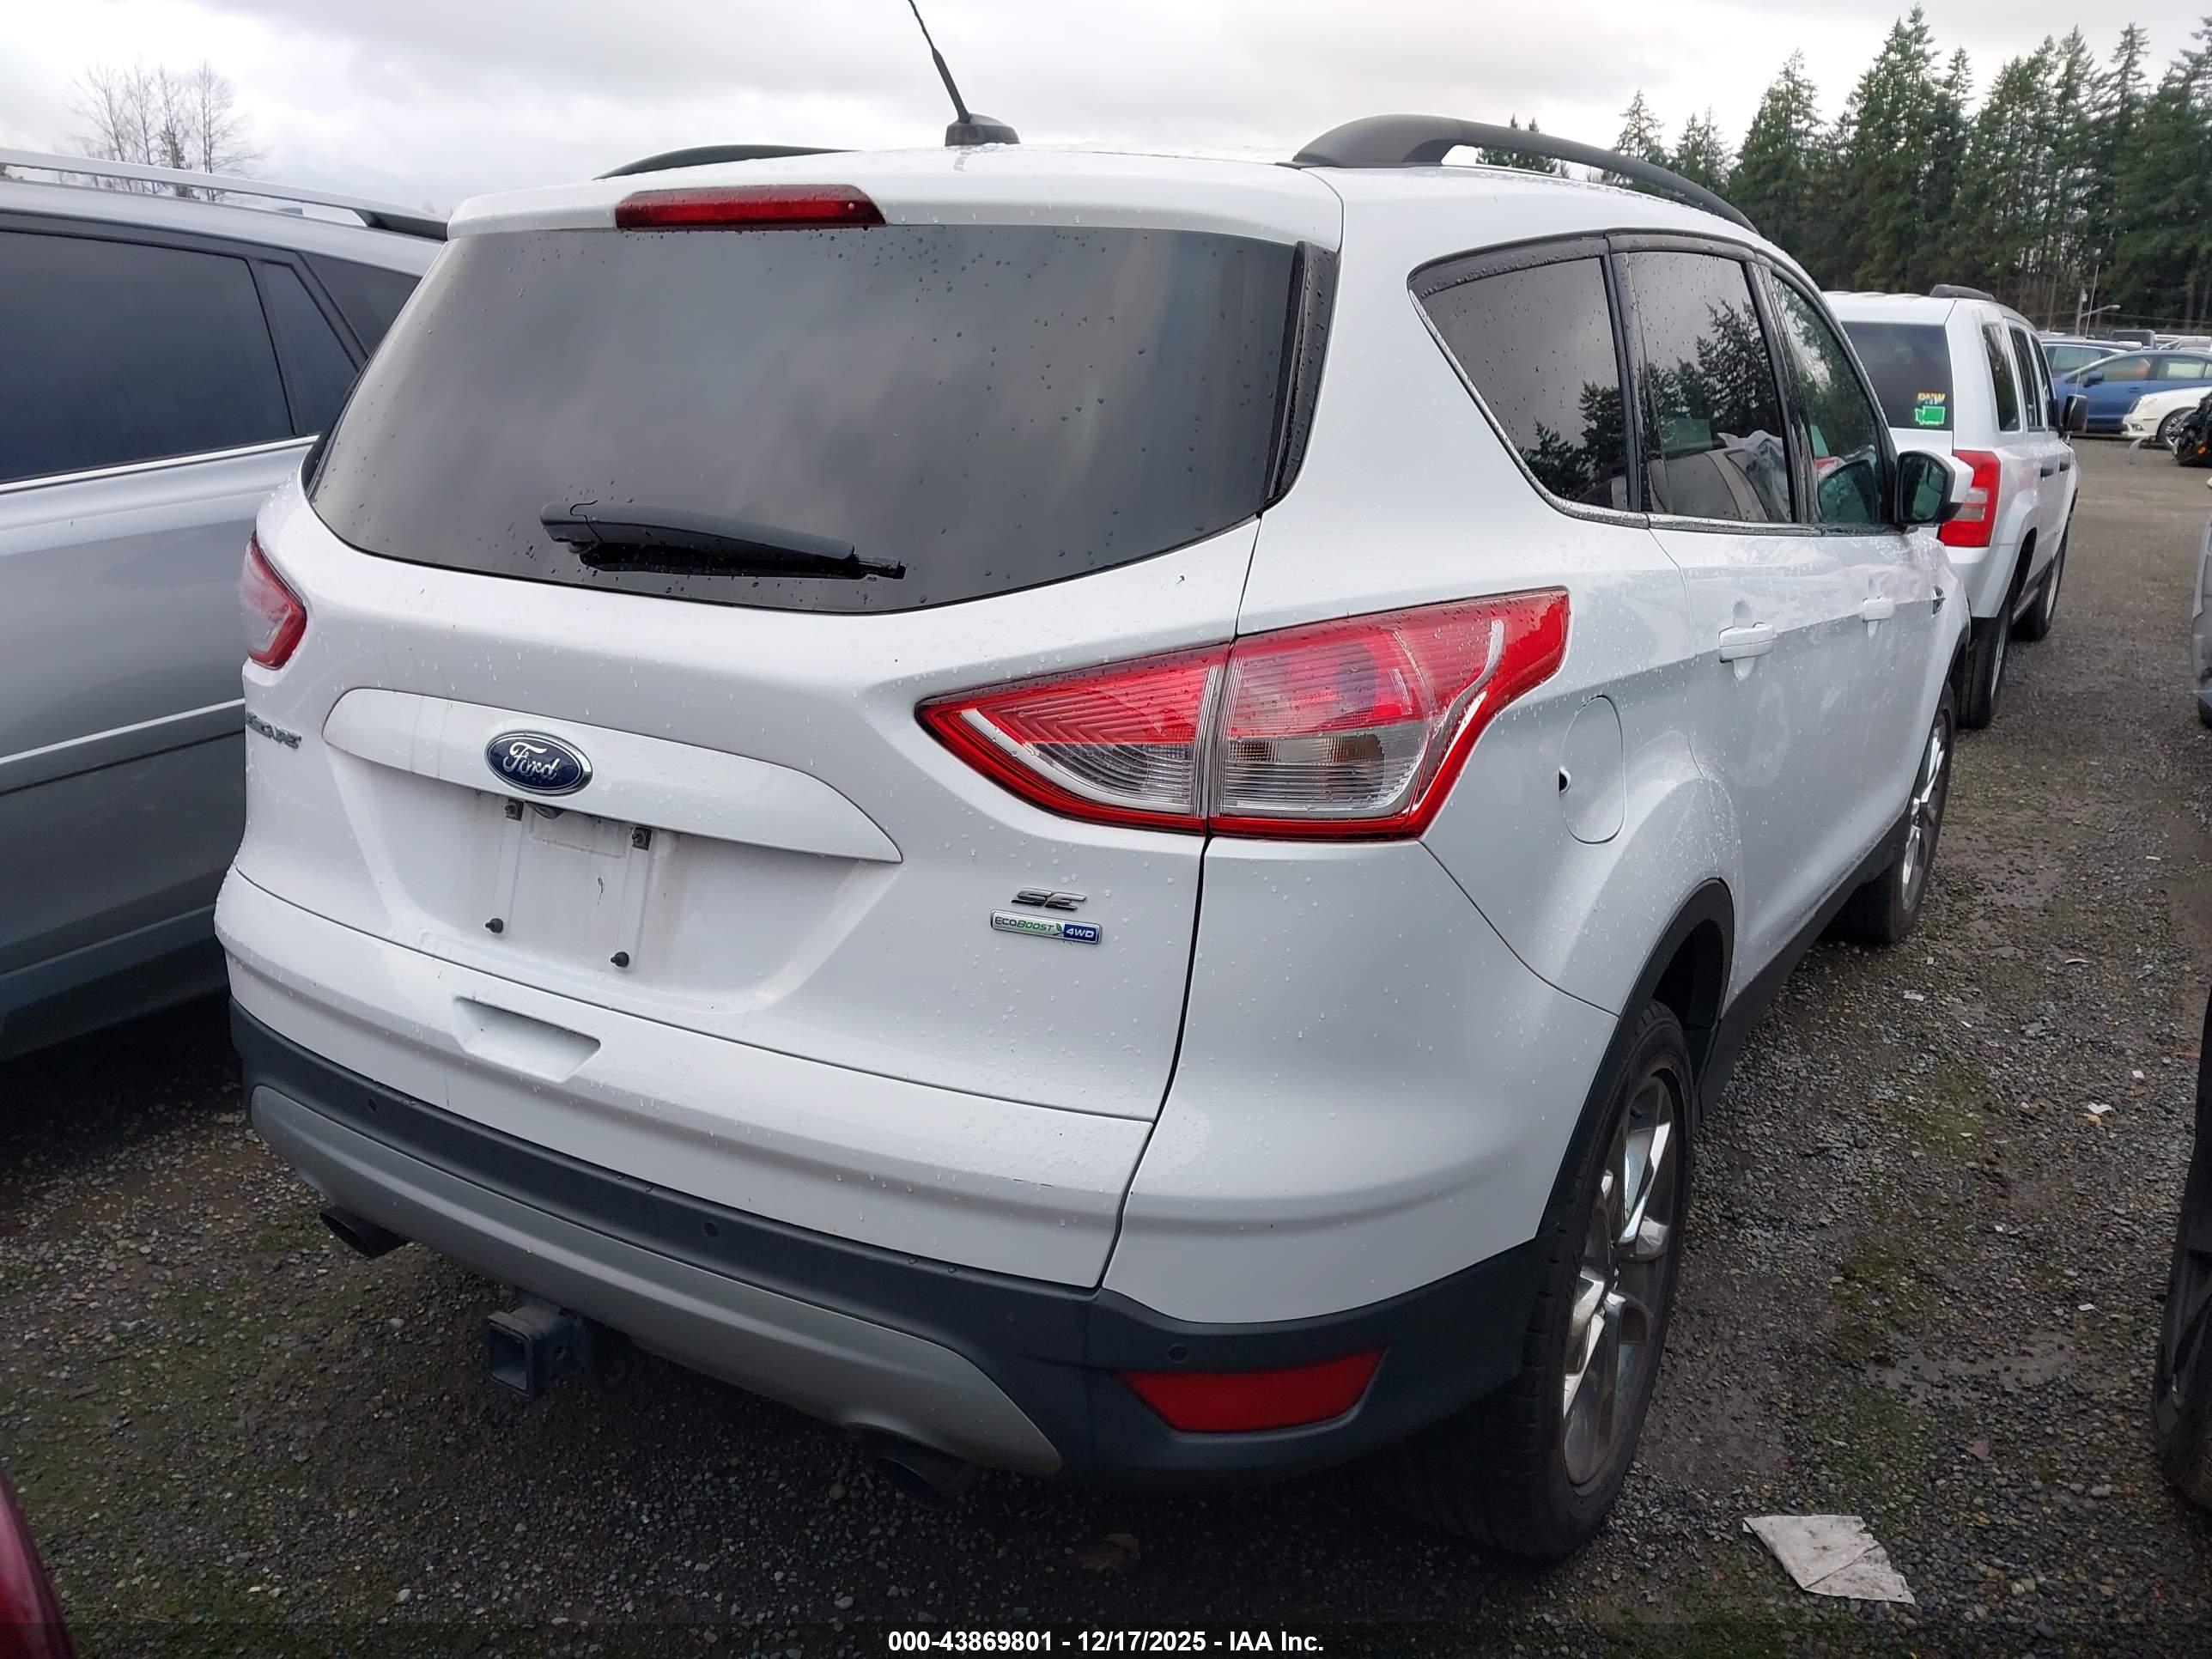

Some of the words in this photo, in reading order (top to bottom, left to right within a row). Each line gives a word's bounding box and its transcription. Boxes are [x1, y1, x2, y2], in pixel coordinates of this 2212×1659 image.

[502, 741, 561, 781] Ford
[1011, 887, 1087, 911] SE
[1066, 927, 1096, 939] 4WD
